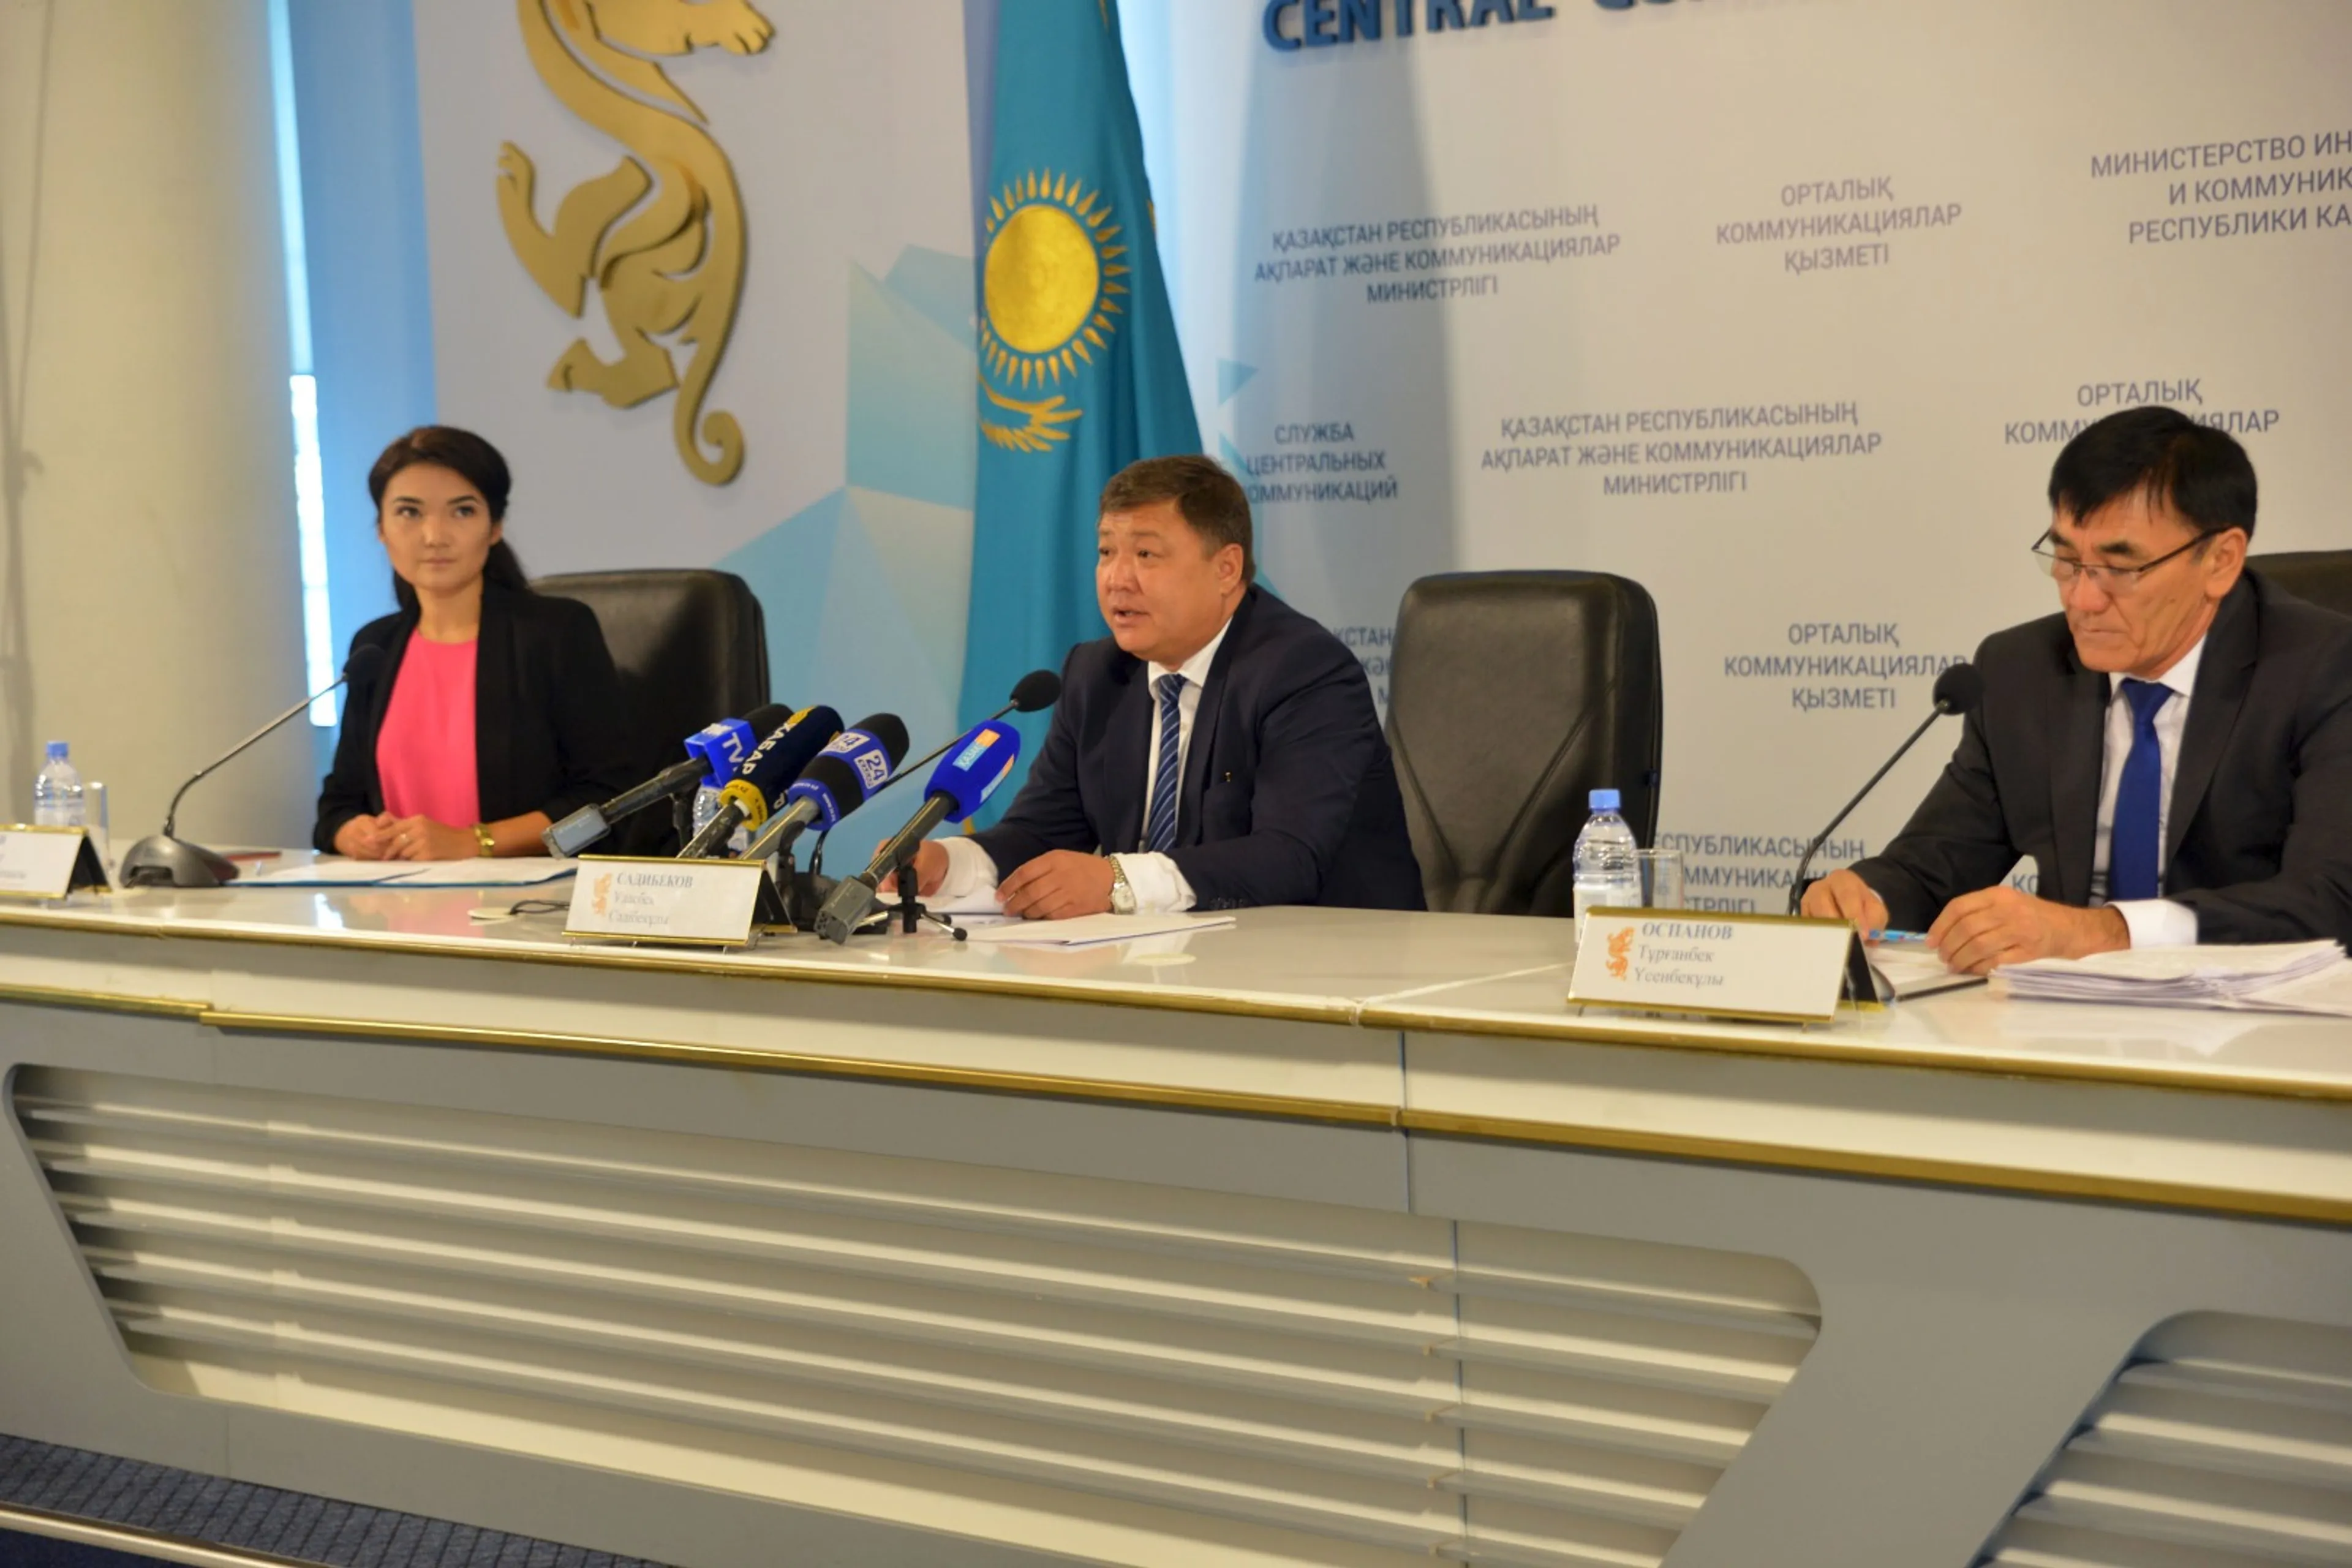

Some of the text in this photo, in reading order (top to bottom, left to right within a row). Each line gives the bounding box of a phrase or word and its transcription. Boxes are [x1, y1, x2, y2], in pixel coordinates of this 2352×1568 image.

[2091, 135, 2305, 178] МИНИСТЕРСТВО
[1781, 176, 1894, 207] ОРТАЛЫҚ
[2169, 183, 2186, 205] И
[1272, 203, 1599, 253] ҚАЗАҚСТАН РЕСПУБЛИКАСЫНЫҢ
[1717, 203, 1962, 244] КОММУНИКАЦИЯЛАР
[2129, 207, 2307, 244] РЕСПУБЛИКИ
[1254, 233, 1621, 284] АҚПАРАТ ЖӘНЕ КОММУНИКАЦИЯЛАР
[1785, 243, 1889, 275] ҚЫЗМЕТІ
[1366, 274, 1499, 304] МИНИСТРЛІГІ
[2077, 378, 2203, 407] ОРТАЛЫҚ
[1275, 422, 1354, 445] СЛУЖБА
[1501, 401, 1858, 442] ҚАЗАҚСТАН РЕСПУБЛИКАСЫНЫҢ
[1246, 450, 1385, 477] ЦЕНТРАЛЬНЫХ
[1482, 432, 1881, 472] АҚПАРАТ ЖӘНЕ КОММУНИКАЦИЯЛАР
[1247, 475, 1398, 504] ОММУНИКАЦИЙ
[1604, 471, 1747, 496] МИНИСТРЛІГІ
[1789, 623, 1900, 647] ОРТАЛЫҚ
[1792, 688, 1896, 711] ҚЫЗМЕТІ
[867, 755, 884, 780] 24
[1642, 922, 1733, 940] ОСПАНОВ
